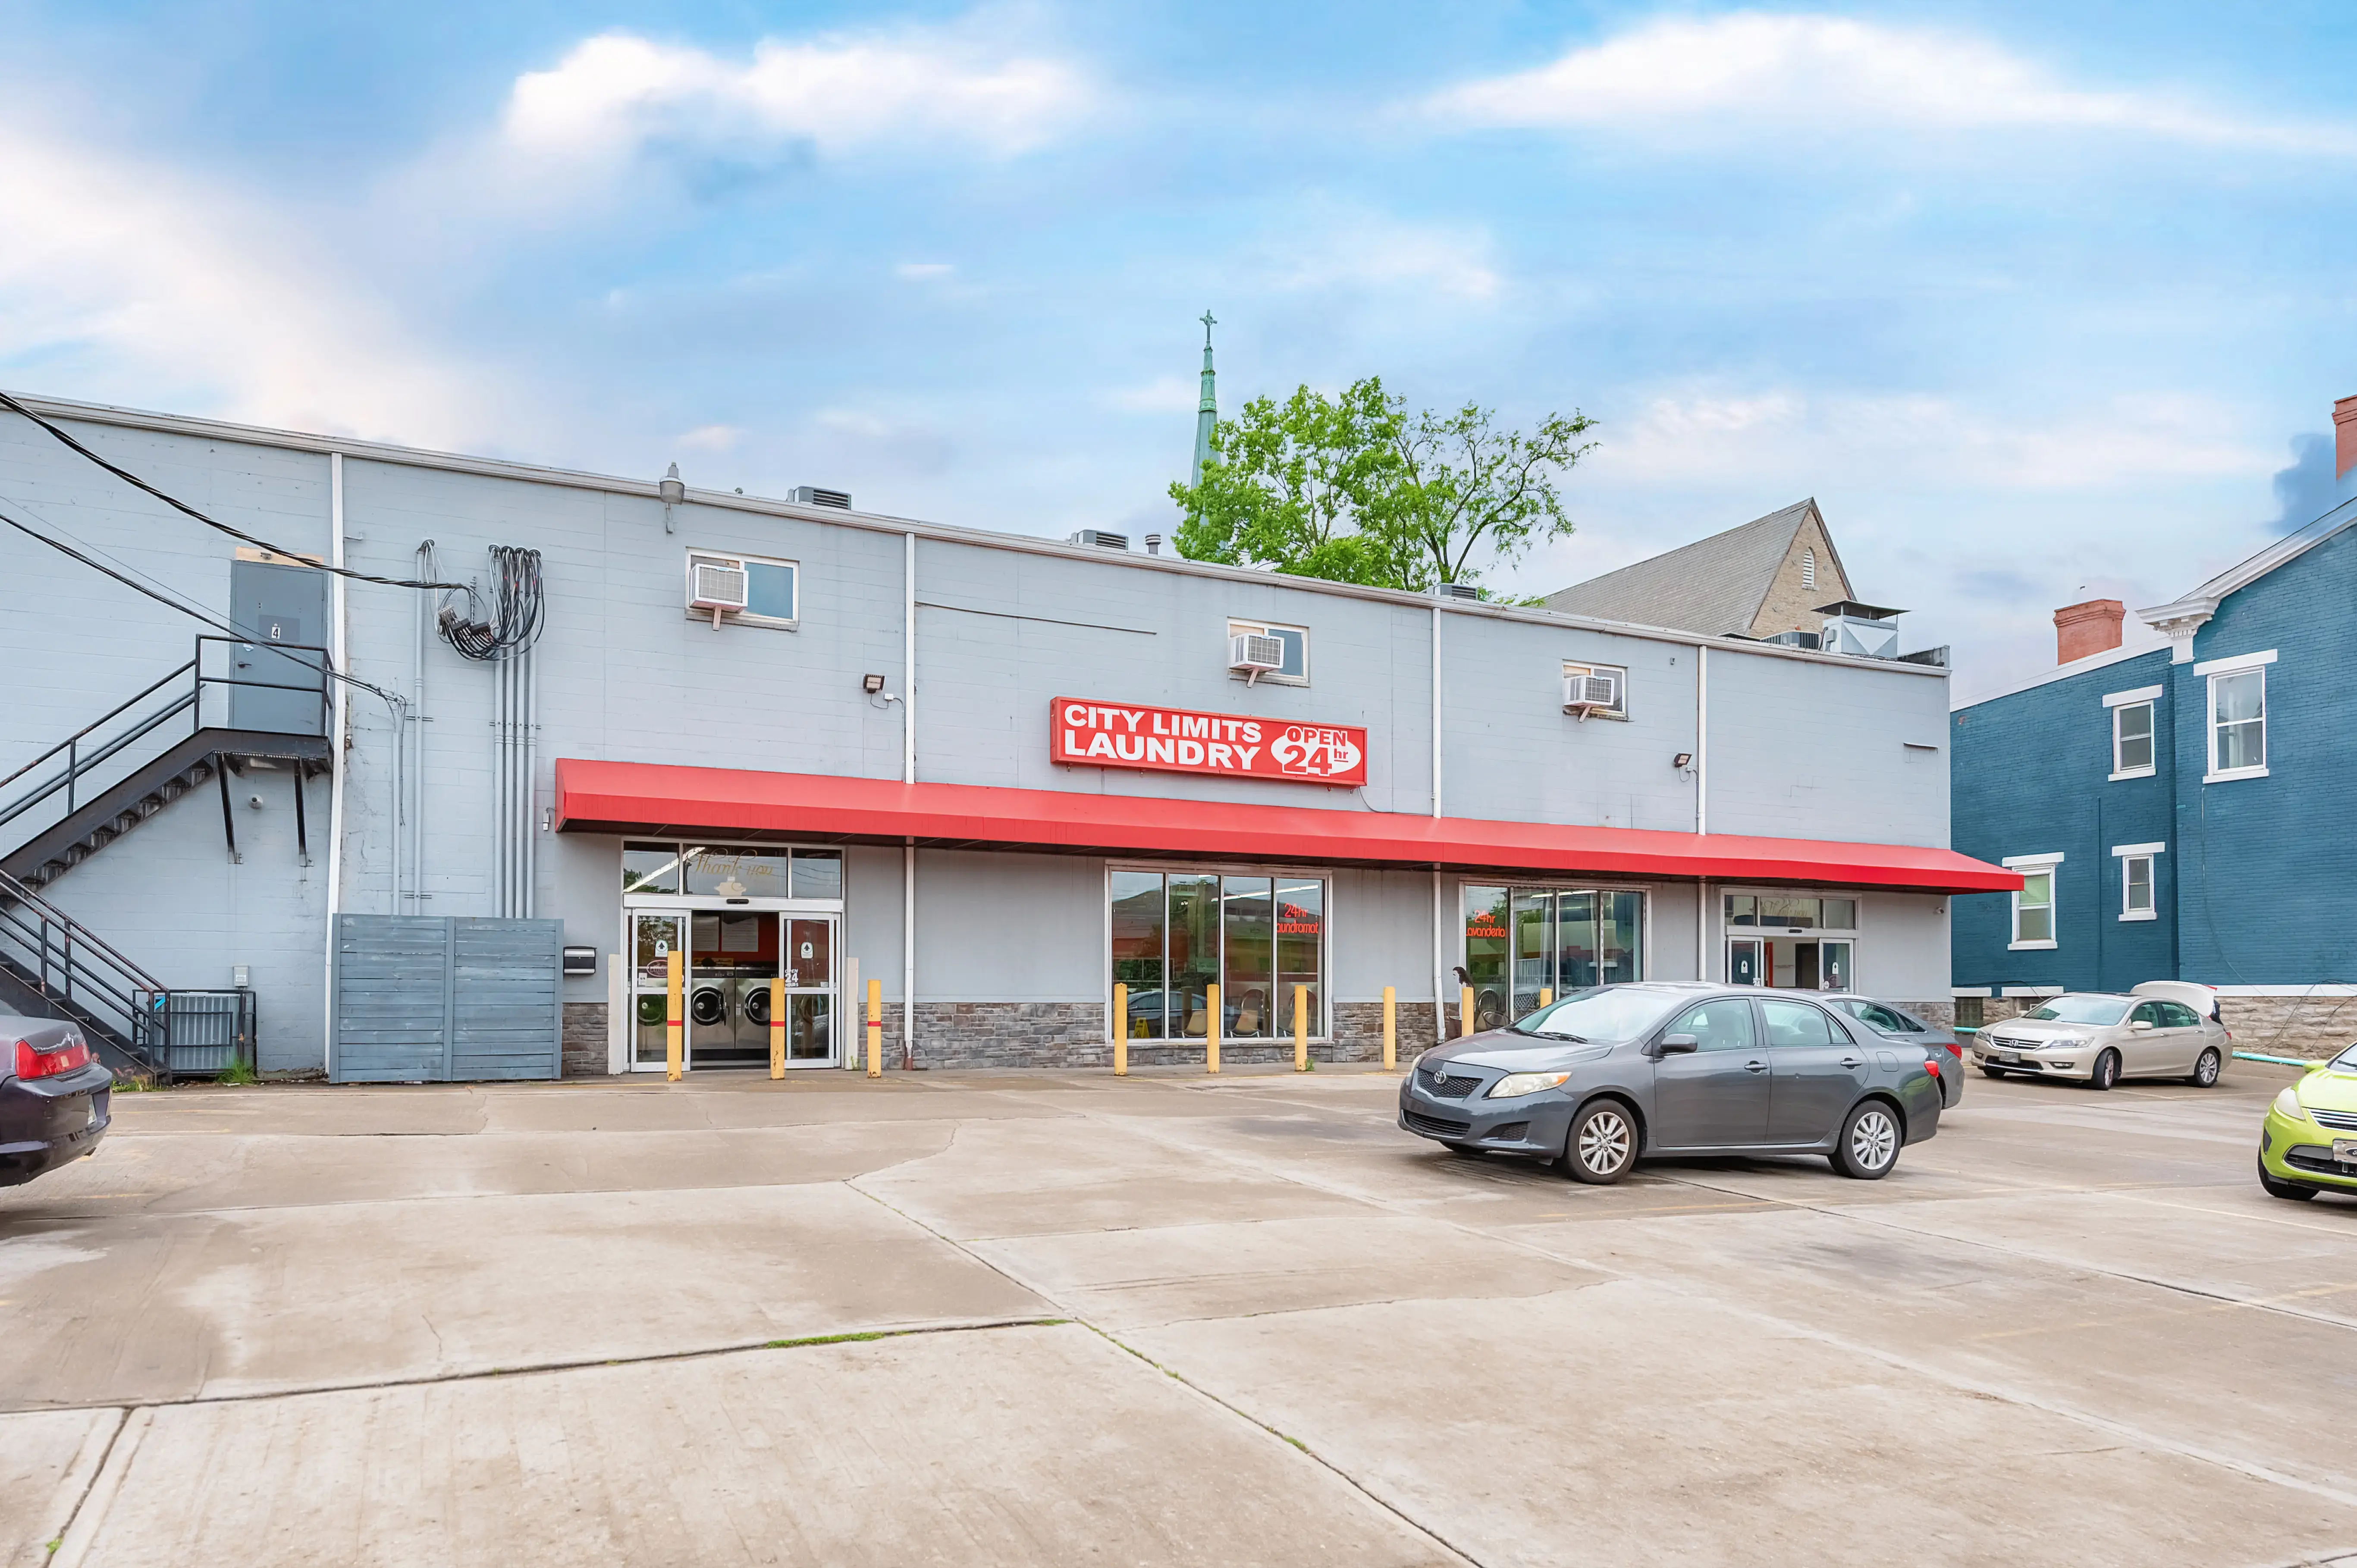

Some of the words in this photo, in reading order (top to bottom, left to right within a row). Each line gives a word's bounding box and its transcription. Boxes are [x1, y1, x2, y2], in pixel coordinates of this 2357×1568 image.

[273, 628, 279, 638] 4
[1064, 704, 1145, 732] CITY
[1153, 713, 1261, 743] LIMITS
[1286, 726, 1346, 746] OPEN
[1065, 729, 1261, 770] LAUNDRY
[1284, 745, 1332, 775] 24
[1334, 749, 1348, 759] hr
[687, 848, 757, 875] Thank
[1284, 903, 1309, 917] 24hr
[1474, 909, 1496, 924] 24hr
[1277, 919, 1318, 934] aundromat
[785, 973, 798, 983] 24
